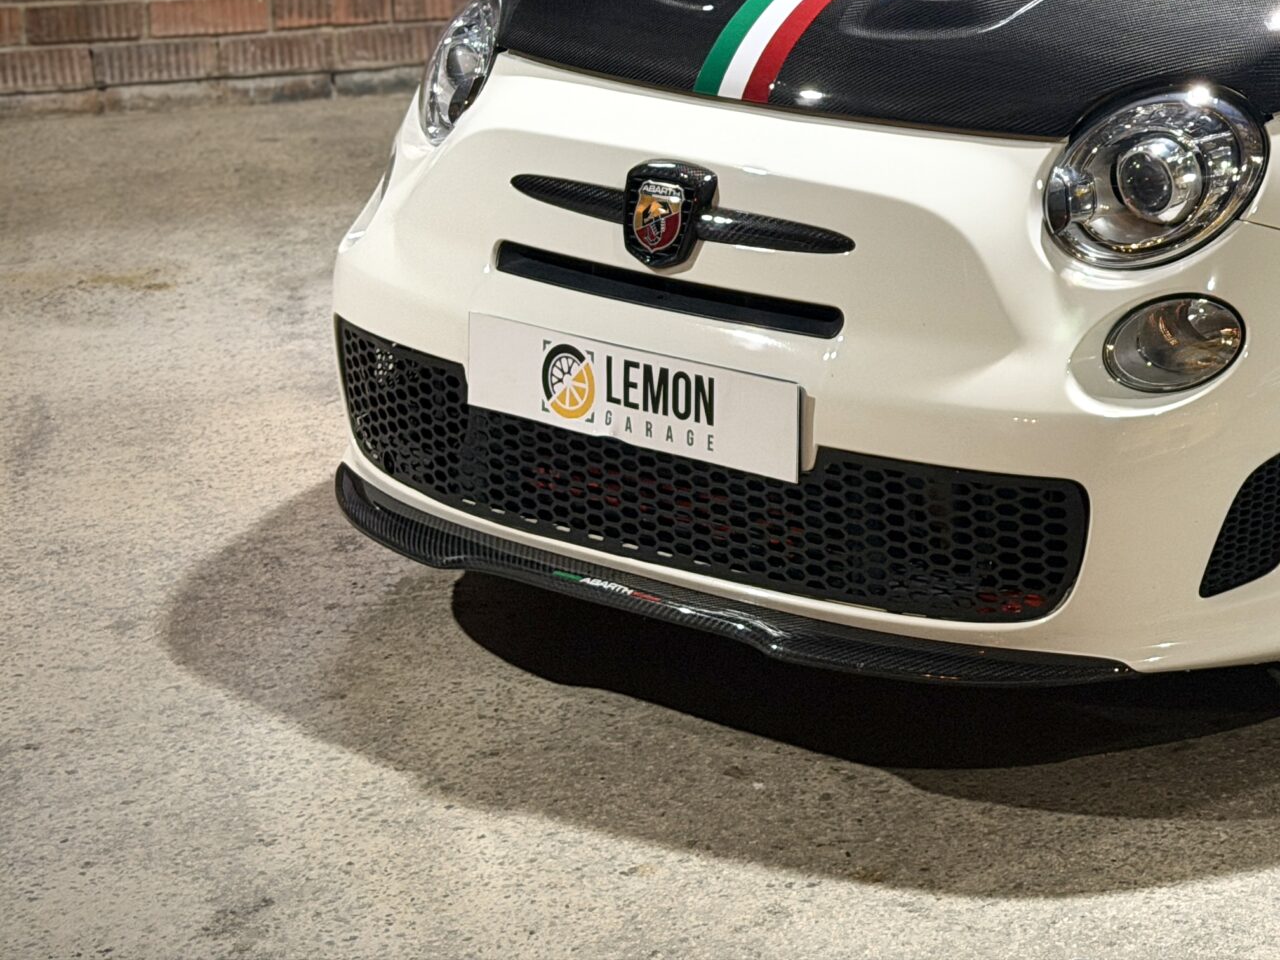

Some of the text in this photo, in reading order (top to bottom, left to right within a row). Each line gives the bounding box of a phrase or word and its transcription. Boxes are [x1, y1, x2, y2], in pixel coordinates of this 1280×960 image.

[642, 184, 681, 197] ABARTH
[605, 355, 715, 427] LEMON
[604, 409, 715, 452] GARAGE
[579, 577, 634, 596] ABARTH
